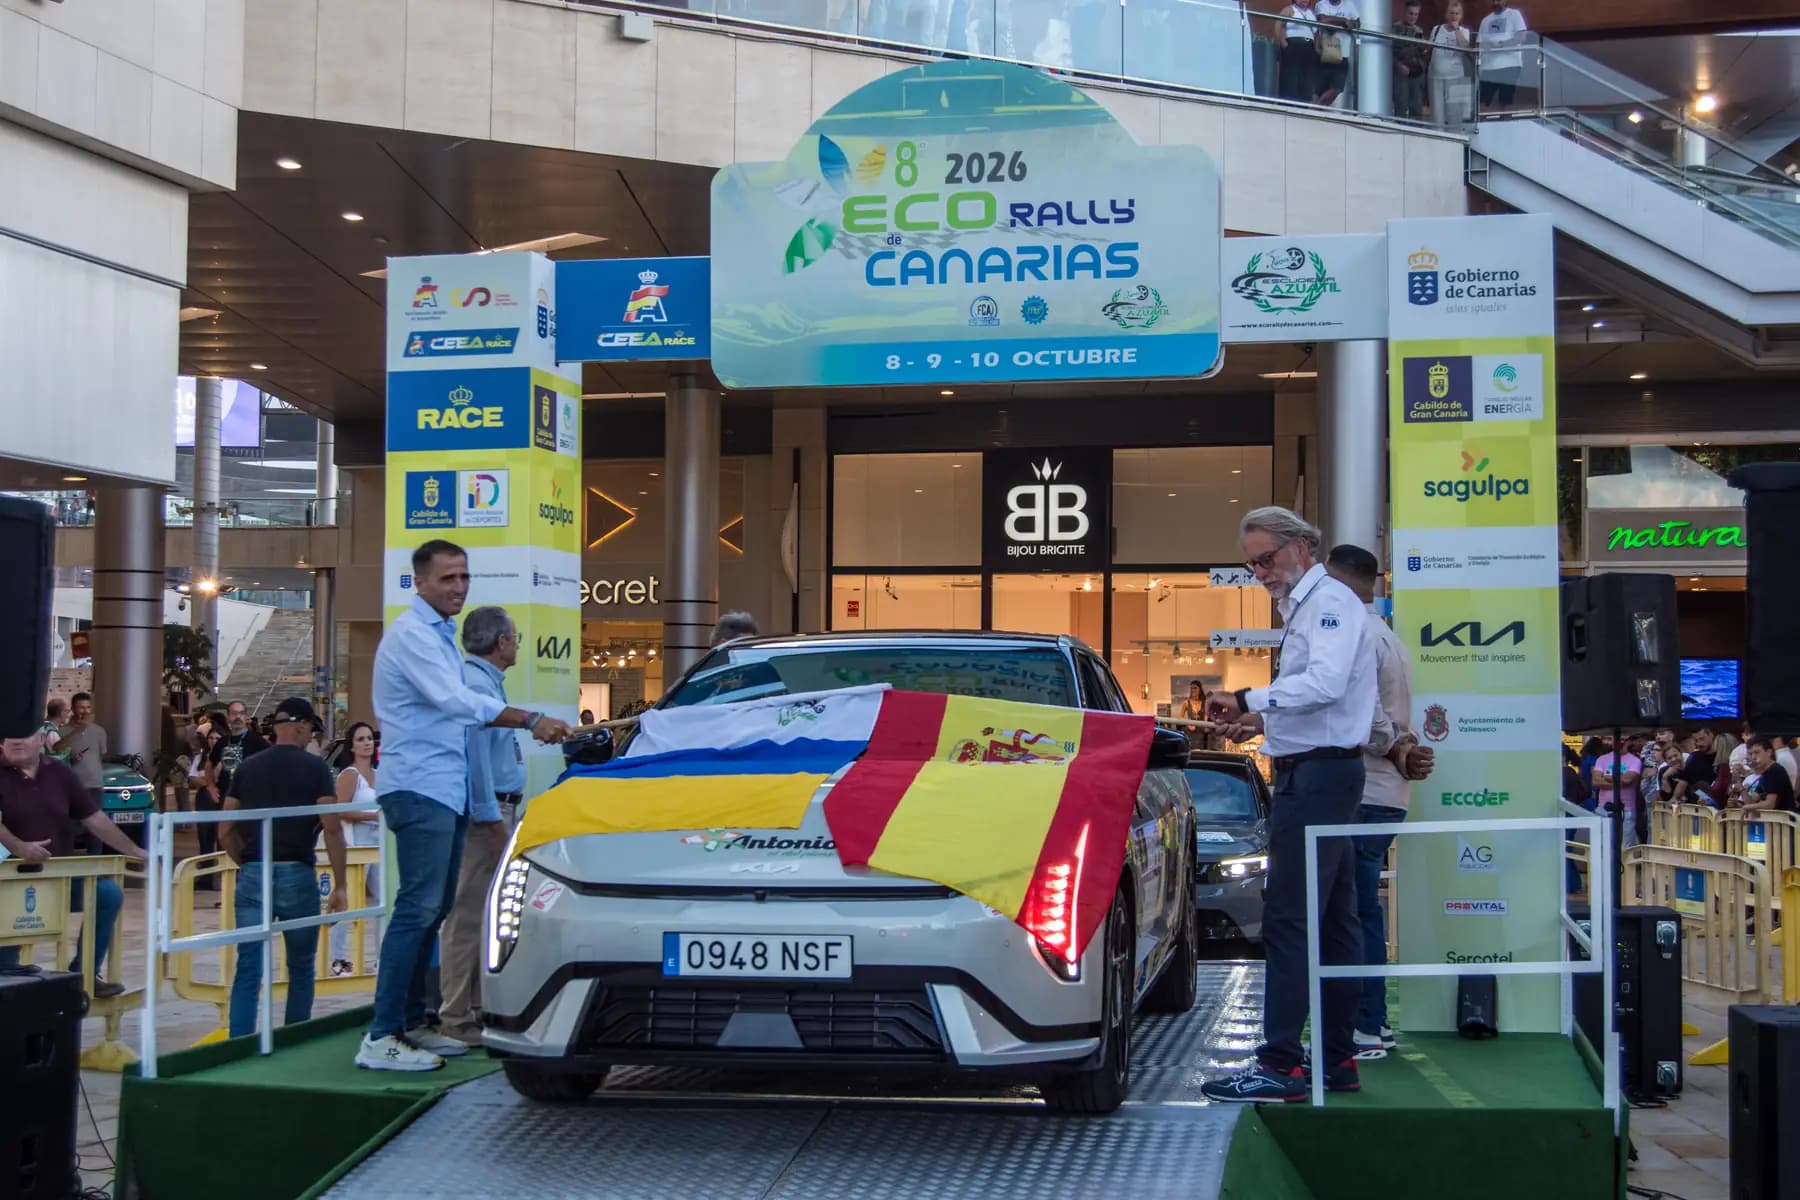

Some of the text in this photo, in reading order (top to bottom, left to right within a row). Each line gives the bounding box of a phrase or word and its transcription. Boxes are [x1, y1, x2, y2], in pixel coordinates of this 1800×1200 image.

[945, 151, 1028, 185] 2026
[842, 191, 1136, 234] ECO RALLY
[887, 234, 902, 246] de
[865, 242, 1140, 287] CANARIAS
[1445, 269, 1520, 283] Gobierno
[1445, 283, 1537, 299] de Canarias
[486, 340, 513, 348] RACE
[597, 331, 696, 348] CEEA RACE
[885, 355, 901, 370] 8
[926, 353, 942, 369] 9
[970, 351, 1000, 368] 10
[1013, 347, 1137, 366] OCTUBRE
[1414, 401, 1462, 410] Cabildo de
[417, 407, 504, 430] RACE
[1410, 409, 1469, 419] Gran Canaria
[1424, 474, 1529, 502] sagulpa
[539, 502, 574, 527] sagulpa
[1607, 520, 1748, 551] natura
[1007, 544, 1086, 557] BIJOU BRIGITTE
[1321, 618, 1338, 627] FIA
[1420, 621, 1526, 647] KIA
[1420, 653, 1526, 664] Movement that inspires
[1458, 716, 1526, 725] Ayuntamiento de
[725, 835, 837, 850] Antonio
[1460, 846, 1493, 863] AG
[667, 958, 675, 968] E
[687, 940, 842, 971] 0948 NSF
[1446, 951, 1512, 964] Sercotel
